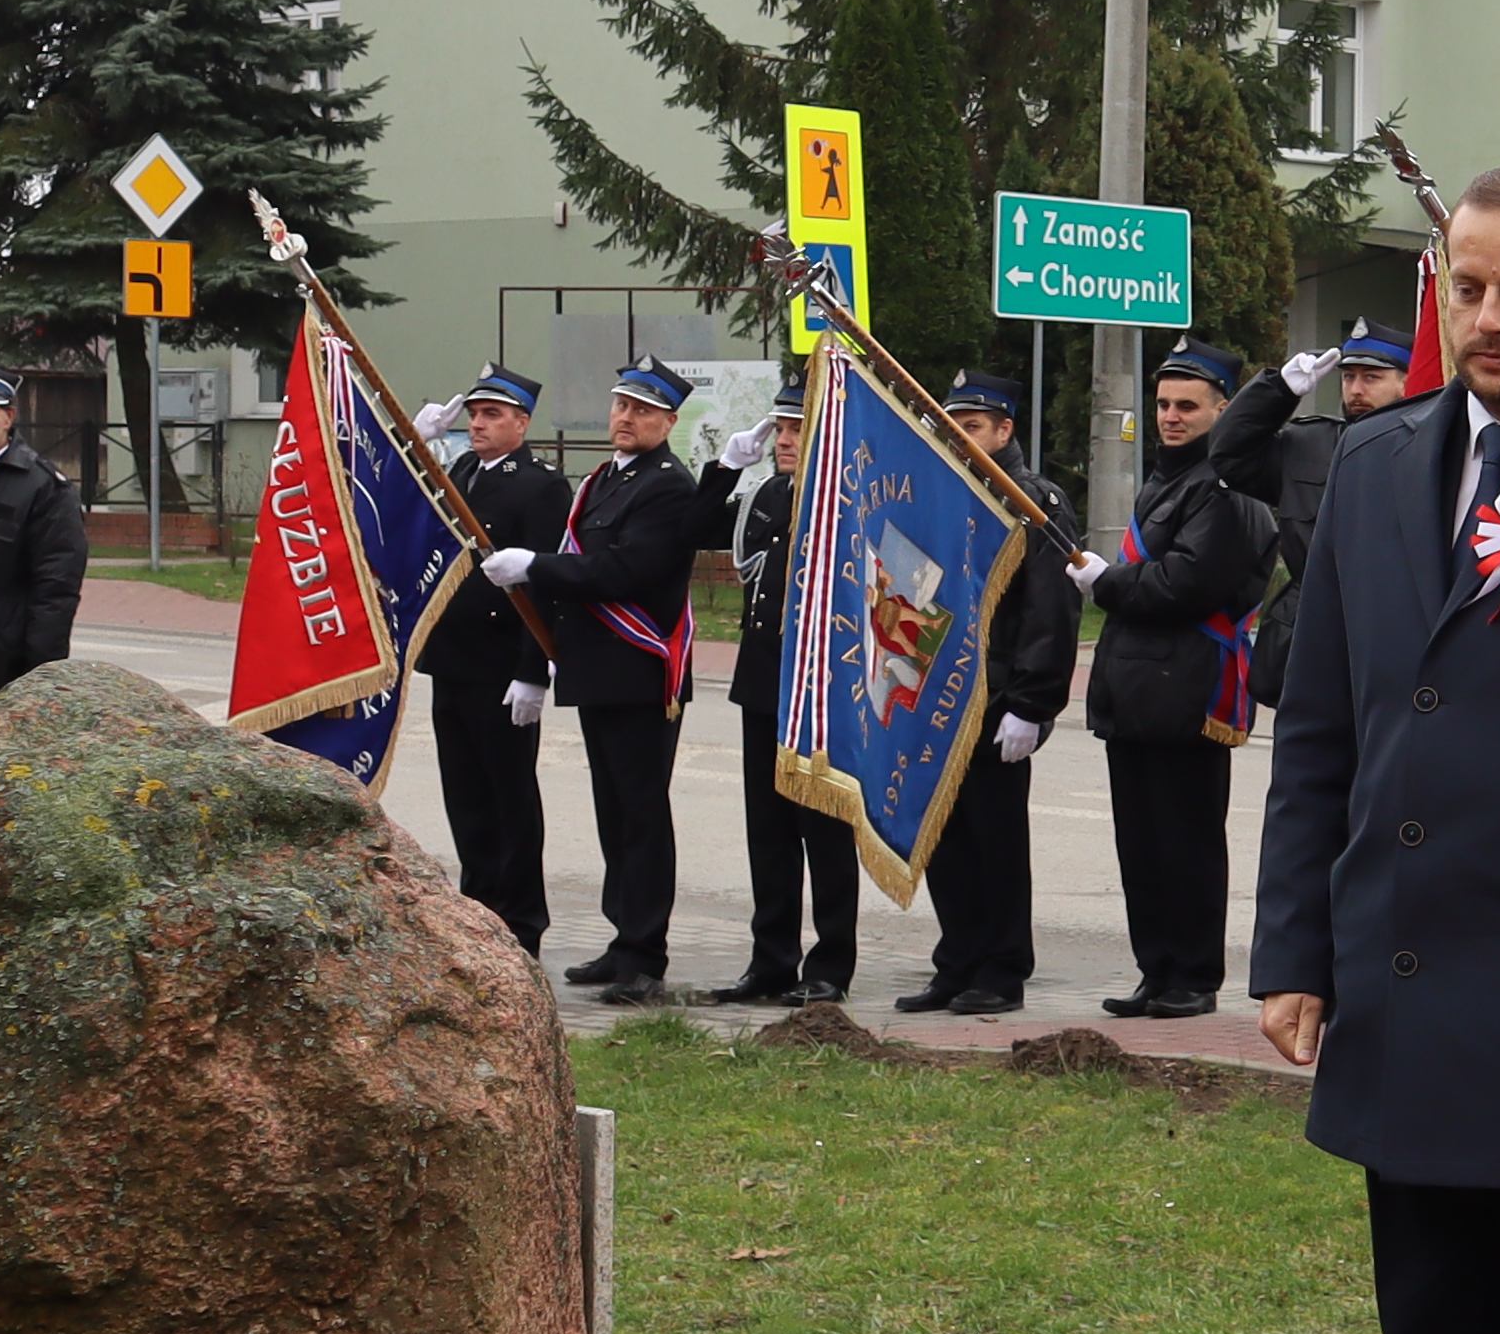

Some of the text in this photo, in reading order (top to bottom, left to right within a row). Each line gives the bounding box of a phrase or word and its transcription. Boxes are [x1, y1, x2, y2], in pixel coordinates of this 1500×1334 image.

[1043, 210, 1145, 252] Zamość
[1040, 262, 1181, 310] Chorupnik
[269, 421, 347, 646] SŁUŻBIE
[416, 548, 445, 596] 2019
